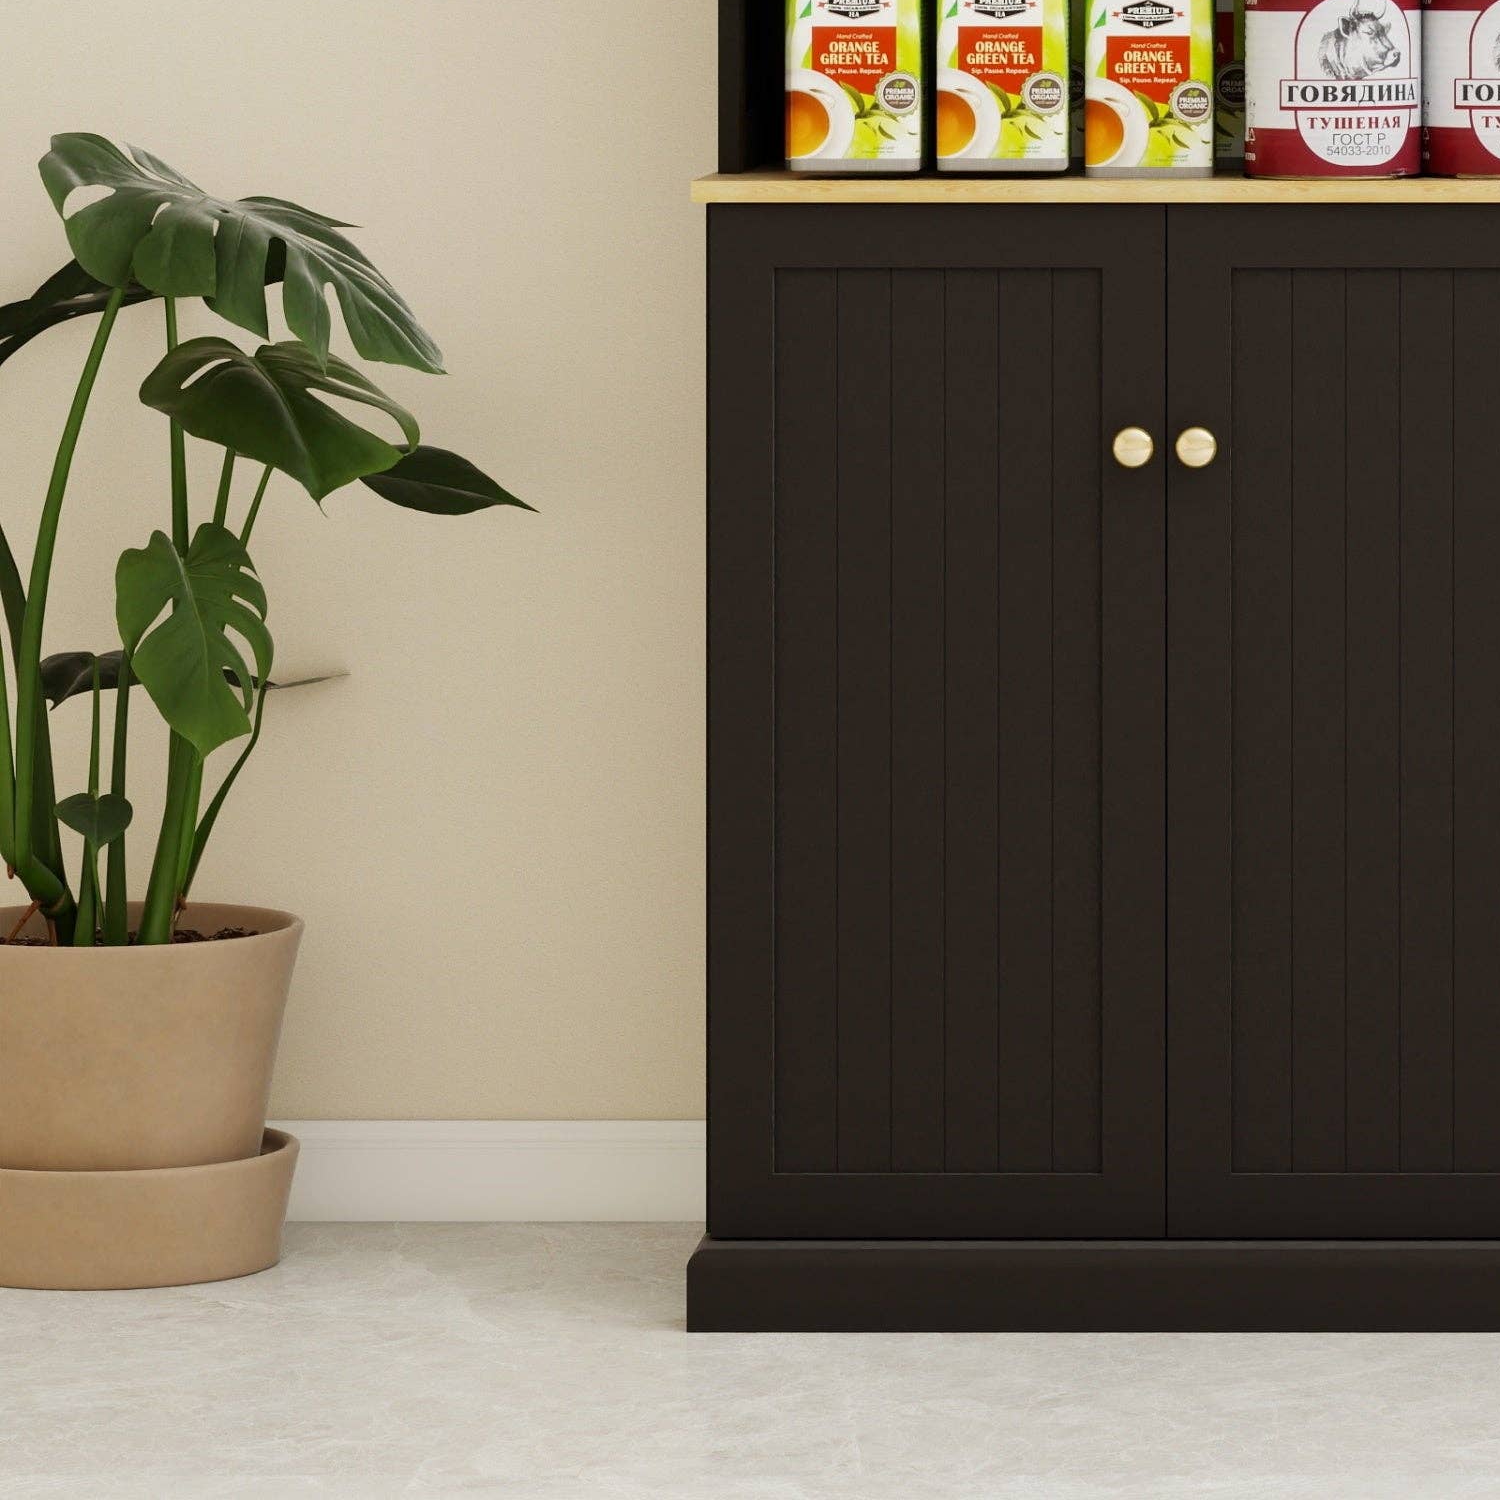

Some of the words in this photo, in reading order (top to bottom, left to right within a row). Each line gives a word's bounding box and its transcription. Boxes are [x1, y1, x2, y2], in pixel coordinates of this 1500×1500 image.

[1127, 7, 1170, 15] PREMIUM
[829, 41, 880, 53] ORANGE
[975, 41, 1026, 53] ORANGE
[820, 53, 862, 65] GREEN
[865, 53, 889, 65] TEA
[966, 53, 1008, 65] GREEN
[1011, 53, 1035, 65] TEA
[1123, 50, 1174, 63] ORANGE
[1114, 62, 1156, 74] GREEN
[1159, 62, 1183, 74] TEA
[884, 87, 915, 95] PREMIUM
[1030, 87, 1061, 95] PREMIUM
[1287, 83, 1416, 105] ГОВЯДИНА
[1178, 96, 1209, 104] PREMIUM
[1306, 116, 1401, 129] ТУШЕНАЯ
[1332, 133, 1373, 146] ГОСТ
[1378, 132, 1386, 145] Р
[1326, 145, 1391, 156] 54033-2010
